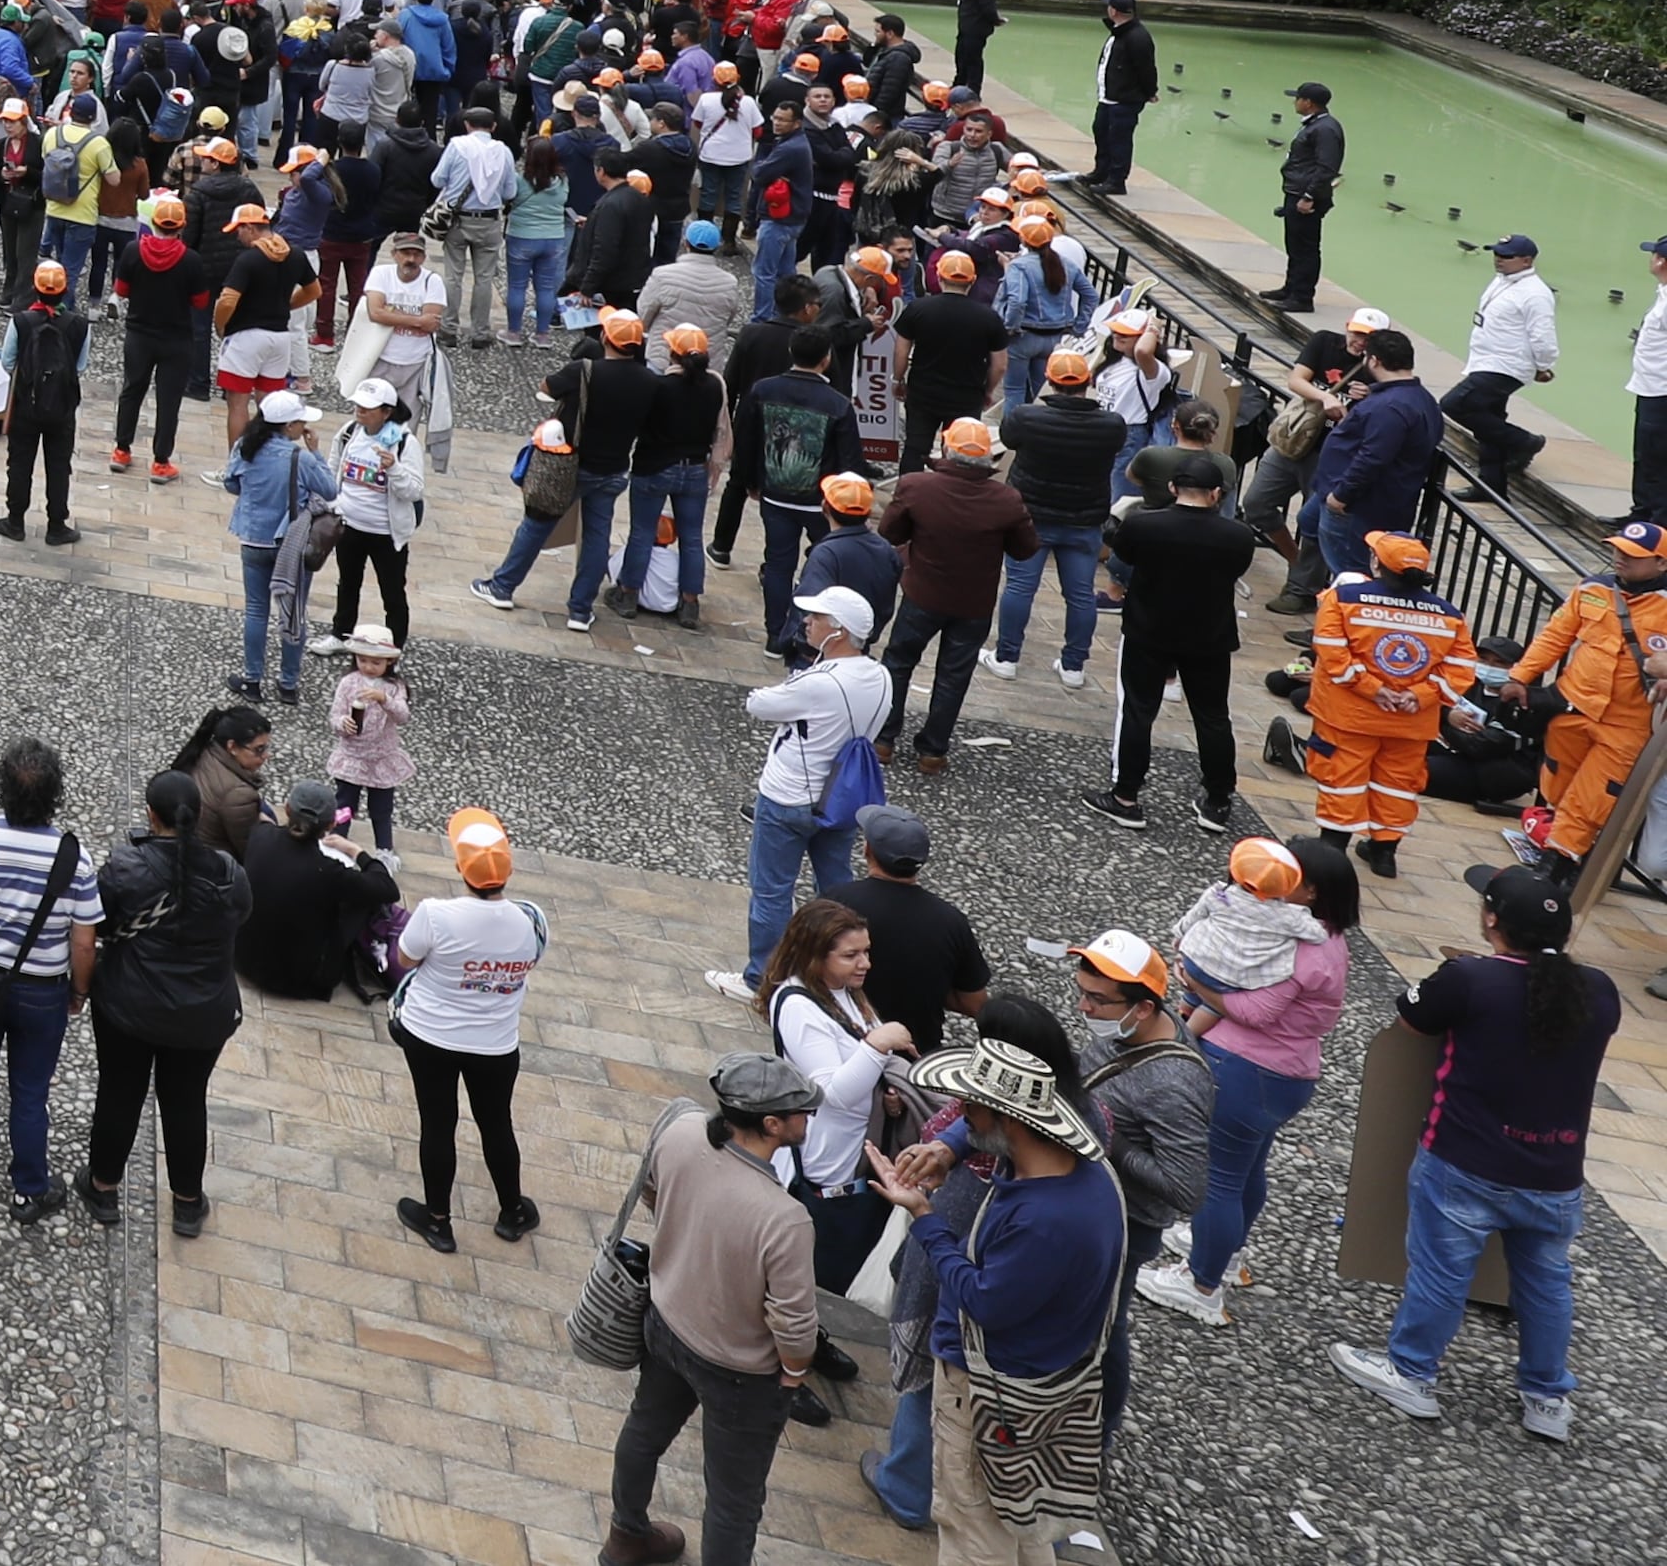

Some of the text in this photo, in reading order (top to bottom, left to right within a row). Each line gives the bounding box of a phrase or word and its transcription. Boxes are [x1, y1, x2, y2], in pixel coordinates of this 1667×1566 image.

[1359, 594, 1445, 614] DEFENSA CIVIL
[1360, 607, 1446, 629] COLOMBIA
